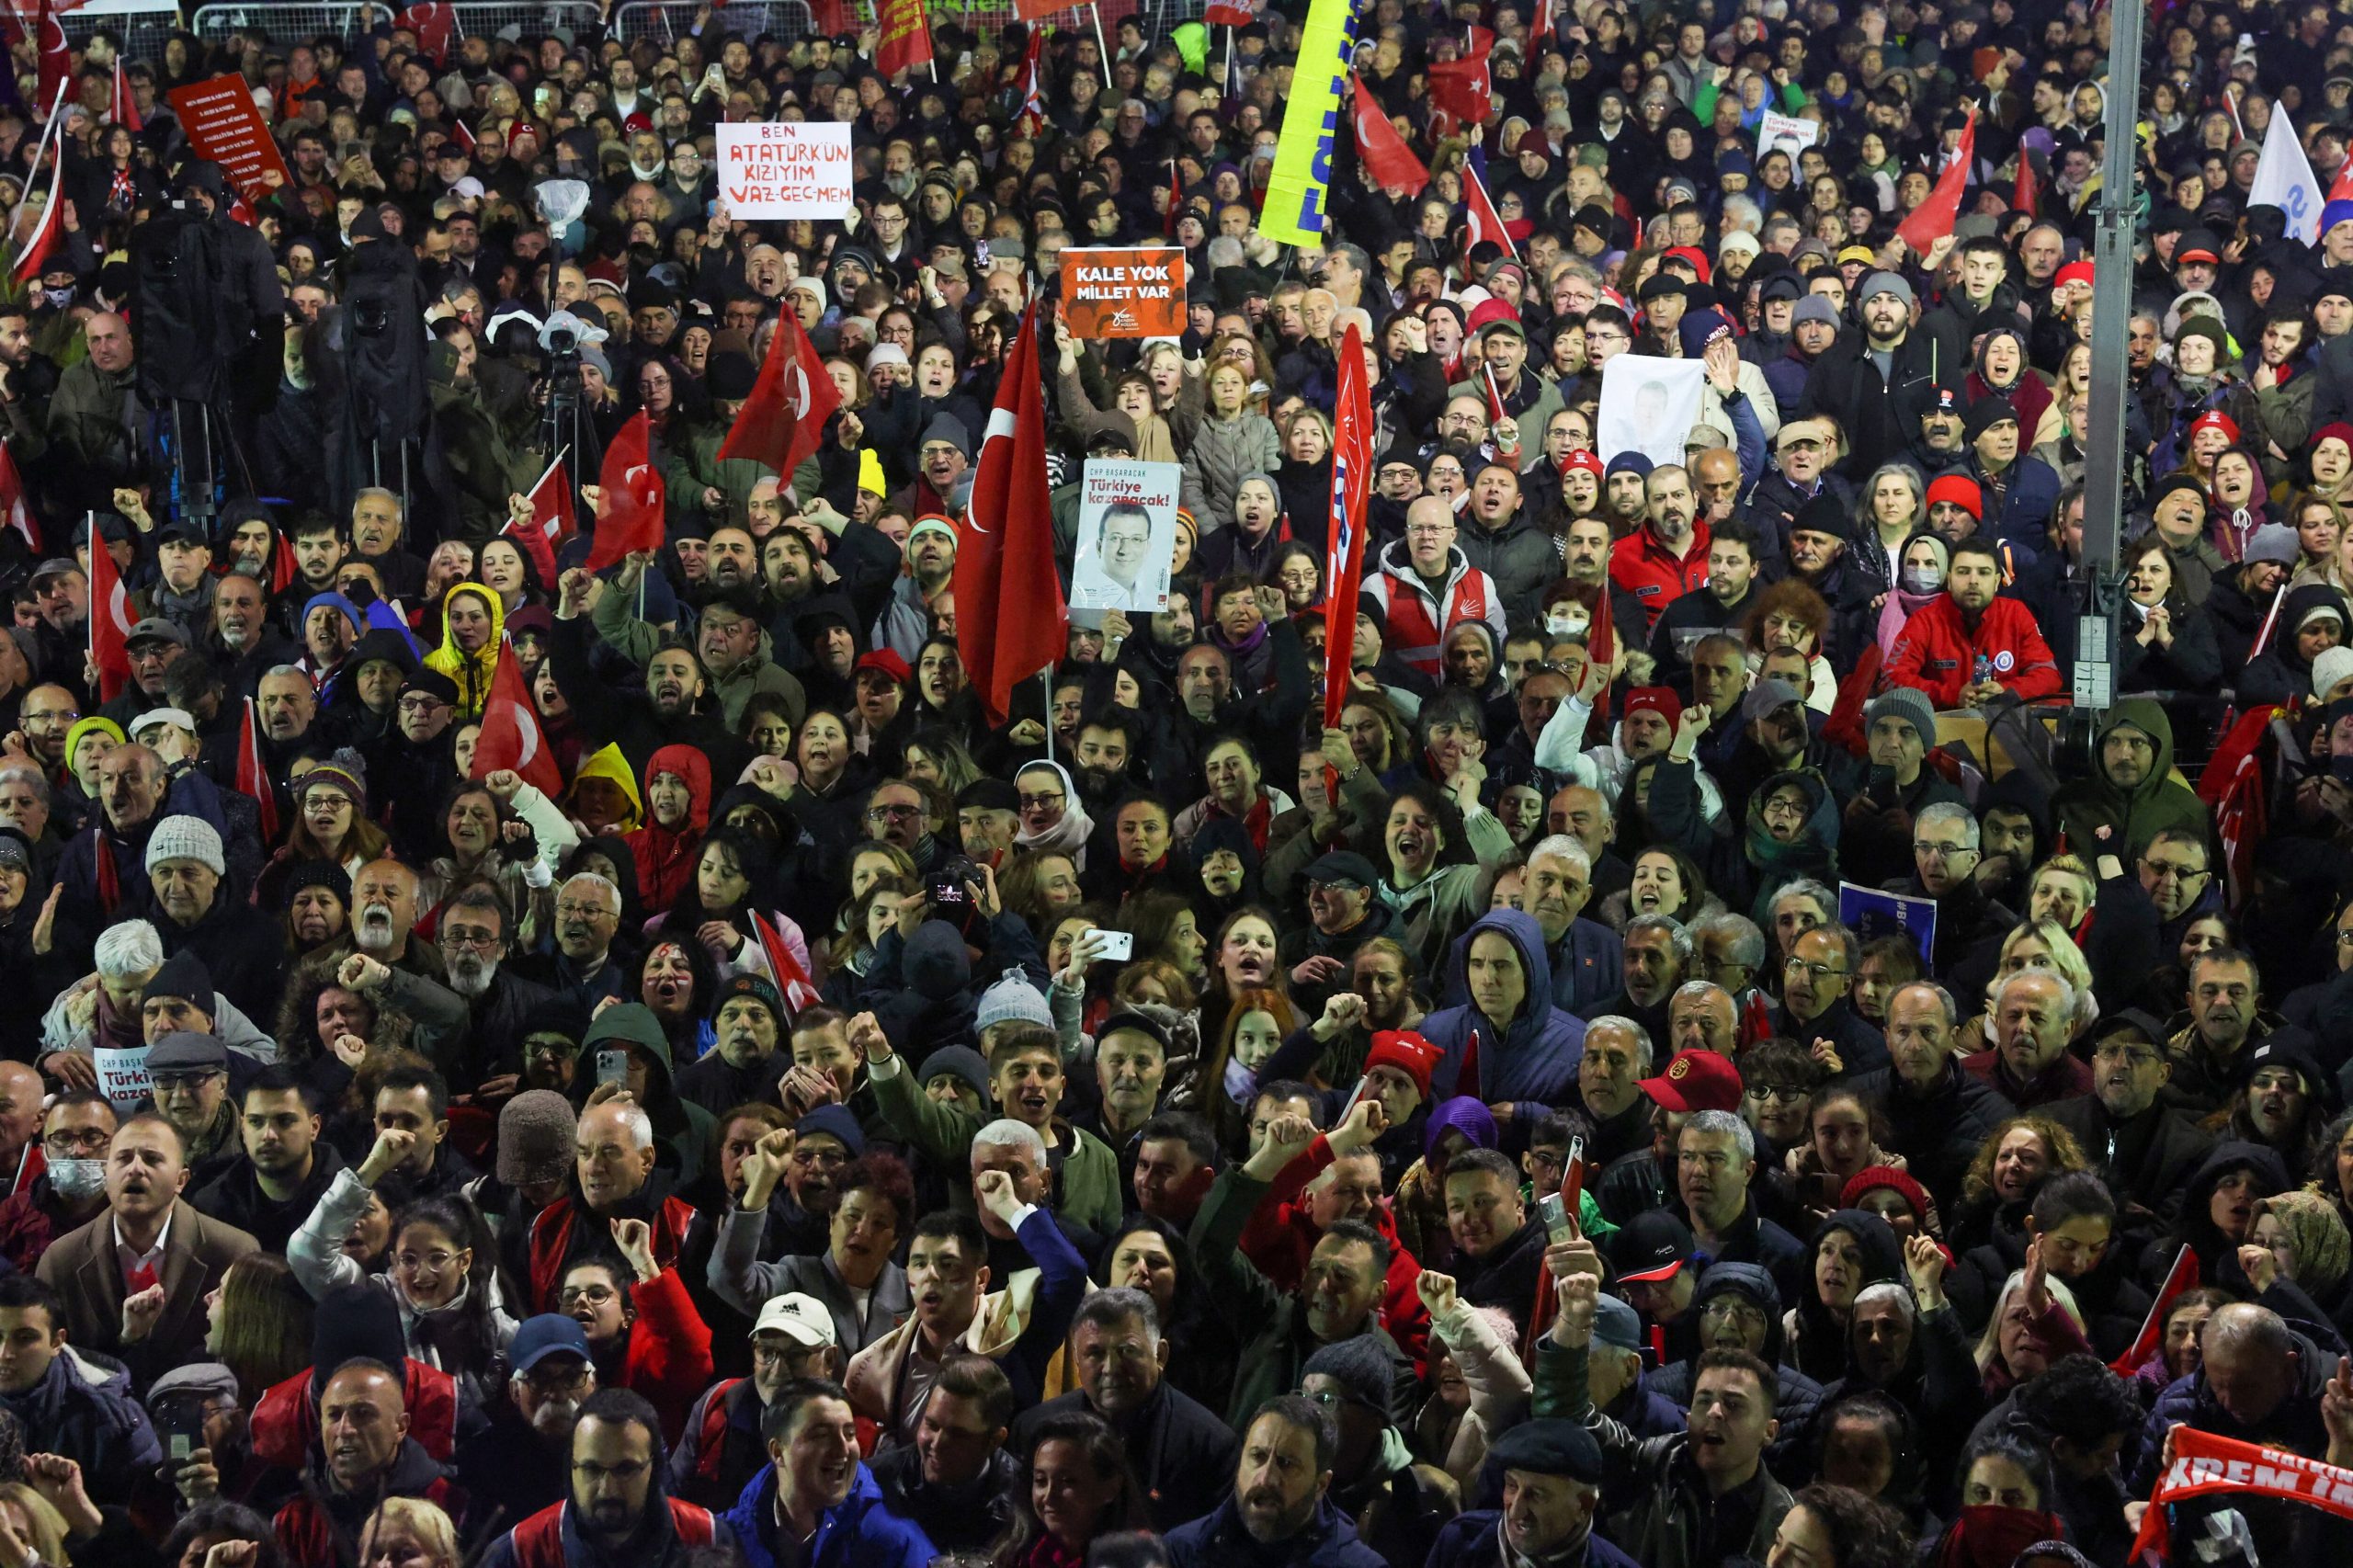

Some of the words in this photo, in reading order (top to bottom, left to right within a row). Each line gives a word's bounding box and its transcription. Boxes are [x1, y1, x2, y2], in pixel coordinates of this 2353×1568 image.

[761, 125, 796, 138] BEN
[730, 142, 849, 163] ATATÜRK'ÜN
[745, 165, 815, 181] KIZIYIM
[1076, 267, 1125, 282] KALE
[1130, 266, 1169, 281] YOK
[1076, 284, 1133, 301] MİLLET
[1137, 286, 1170, 299] VAR
[1089, 468, 1104, 476] CHP
[1106, 468, 1147, 478] BAŞARACAK
[1089, 479, 1142, 494] Türkiye
[1088, 492, 1170, 506] kazanacak!
[102, 1059, 116, 1068] CHP
[104, 1069, 150, 1085] Türki
[108, 1086, 153, 1101] kaza
[2161, 1457, 2300, 1493] KREM
